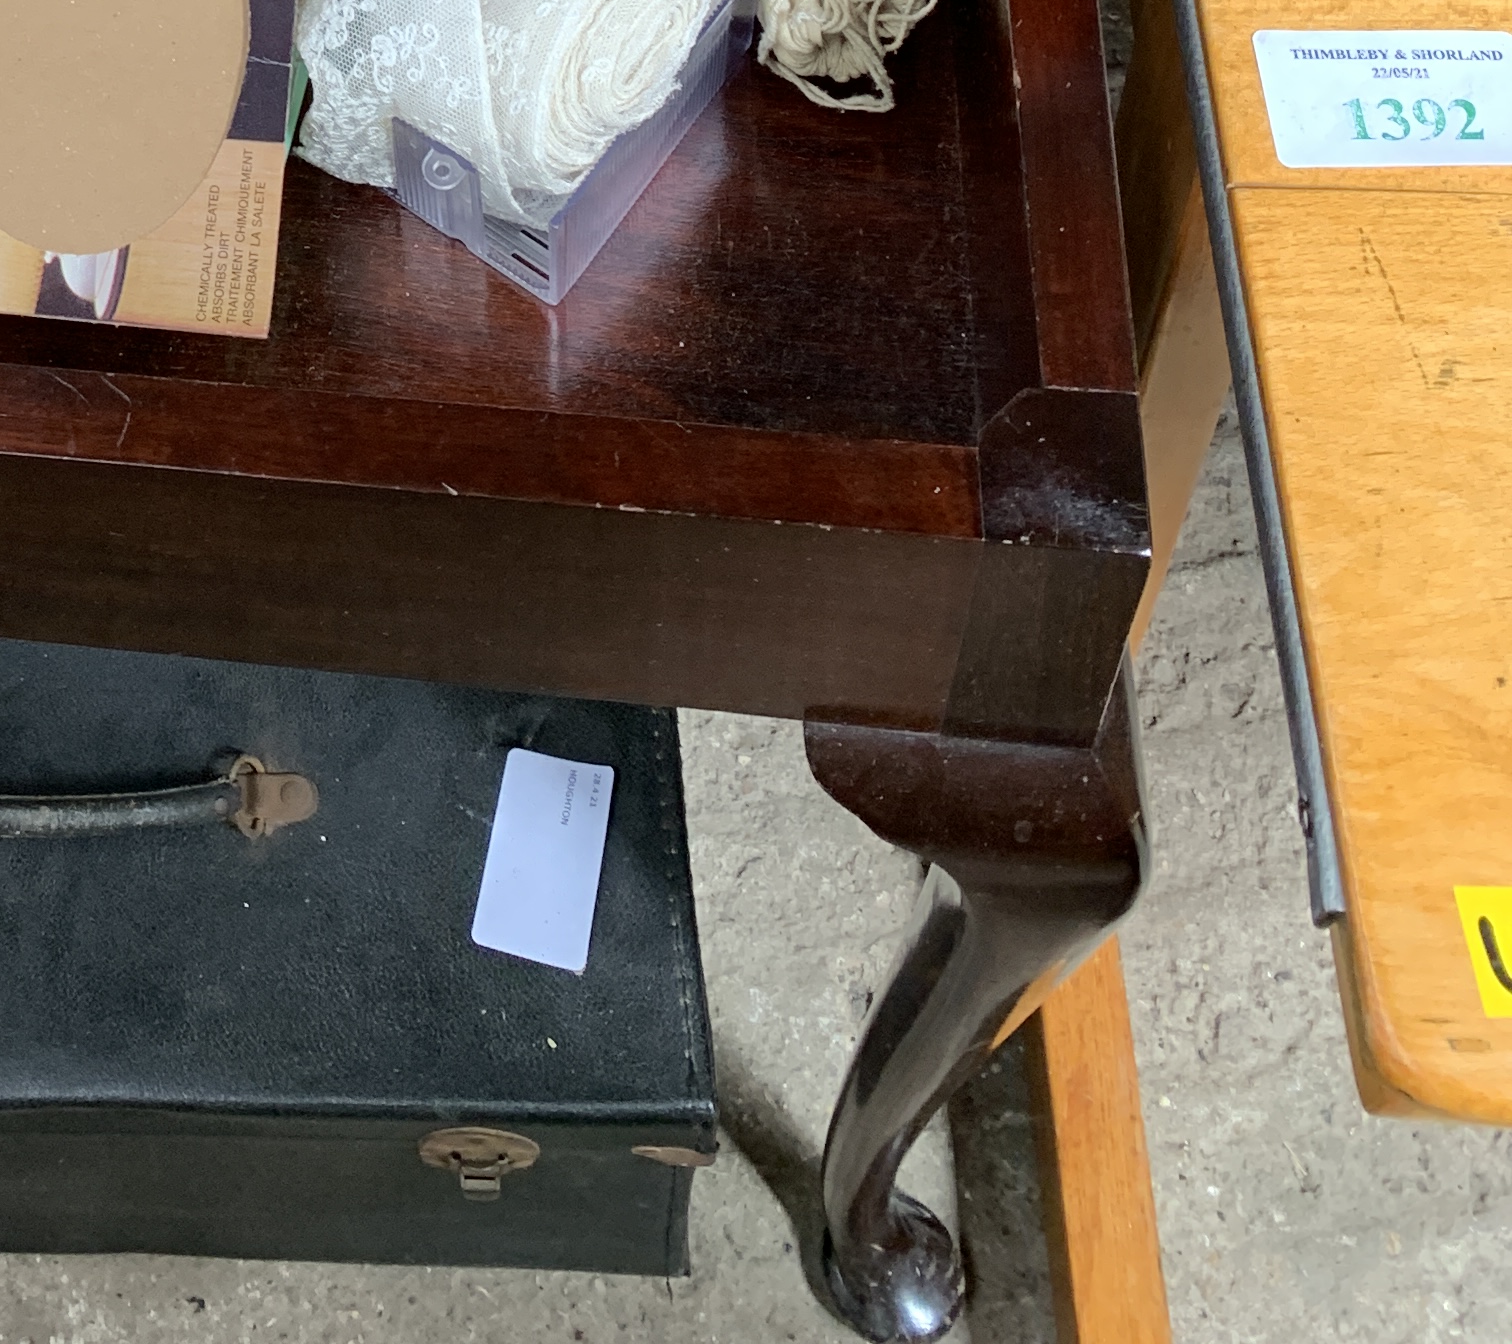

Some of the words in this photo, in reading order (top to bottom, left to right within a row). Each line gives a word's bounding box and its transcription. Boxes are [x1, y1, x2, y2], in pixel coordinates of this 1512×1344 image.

[1290, 48, 1389, 60] THIMBLEBY
[1394, 49, 1408, 60] &
[1412, 49, 1503, 61] SHORLAND
[1342, 98, 1485, 141] 1392
[204, 184, 221, 239] TREATED
[252, 181, 267, 228] SALETE
[218, 231, 231, 259] DIRT
[226, 248, 244, 324] TRAITEMENT
[237, 148, 254, 243] CHIMIQUEMENT
[251, 232, 262, 248] LA
[195, 243, 214, 322] CHEMICALLY
[211, 263, 228, 324] ABSORBS
[242, 253, 260, 327] ABSORBANT
[560, 769, 578, 826] HOUGHTON
